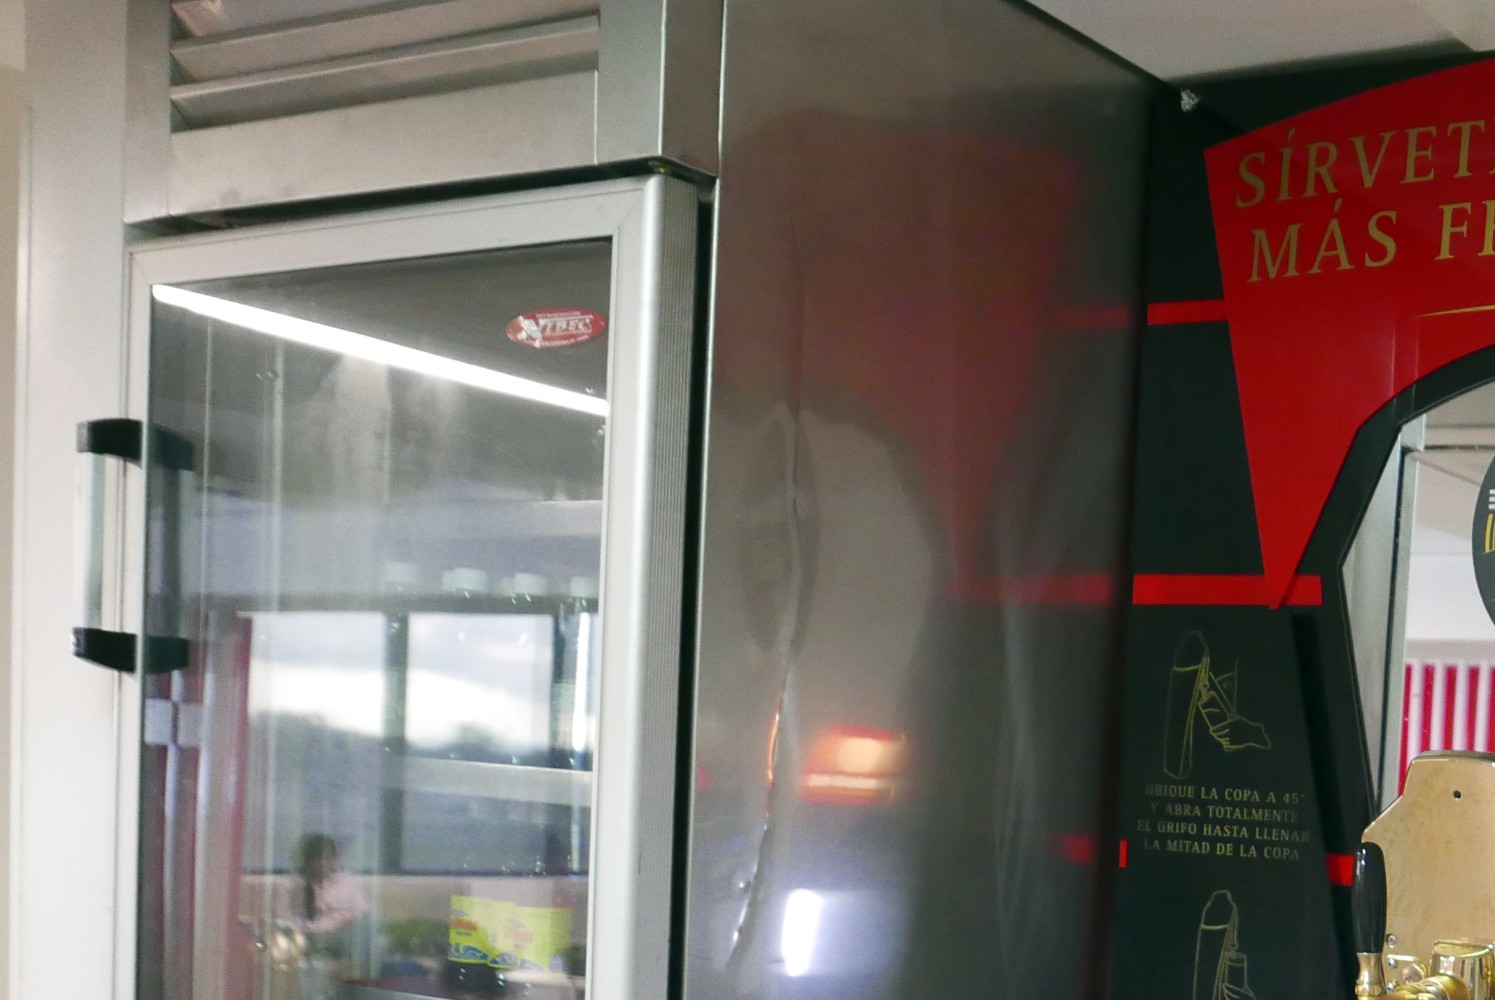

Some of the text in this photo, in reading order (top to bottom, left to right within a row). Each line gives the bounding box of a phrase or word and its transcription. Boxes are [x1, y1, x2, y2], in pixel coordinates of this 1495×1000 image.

[1247, 199, 1400, 284] MÁS
[1145, 783, 1195, 799] UBIQUE
[1200, 785, 1219, 800] LA
[1224, 788, 1259, 803] COPA
[1266, 790, 1277, 804] A
[1150, 801, 1299, 824] Y ABRA TOTALMENTE
[1137, 818, 1310, 844] EL GRIFO HASTA LLENAR
[1143, 837, 1300, 862] LA MITAD DE LA COPA
